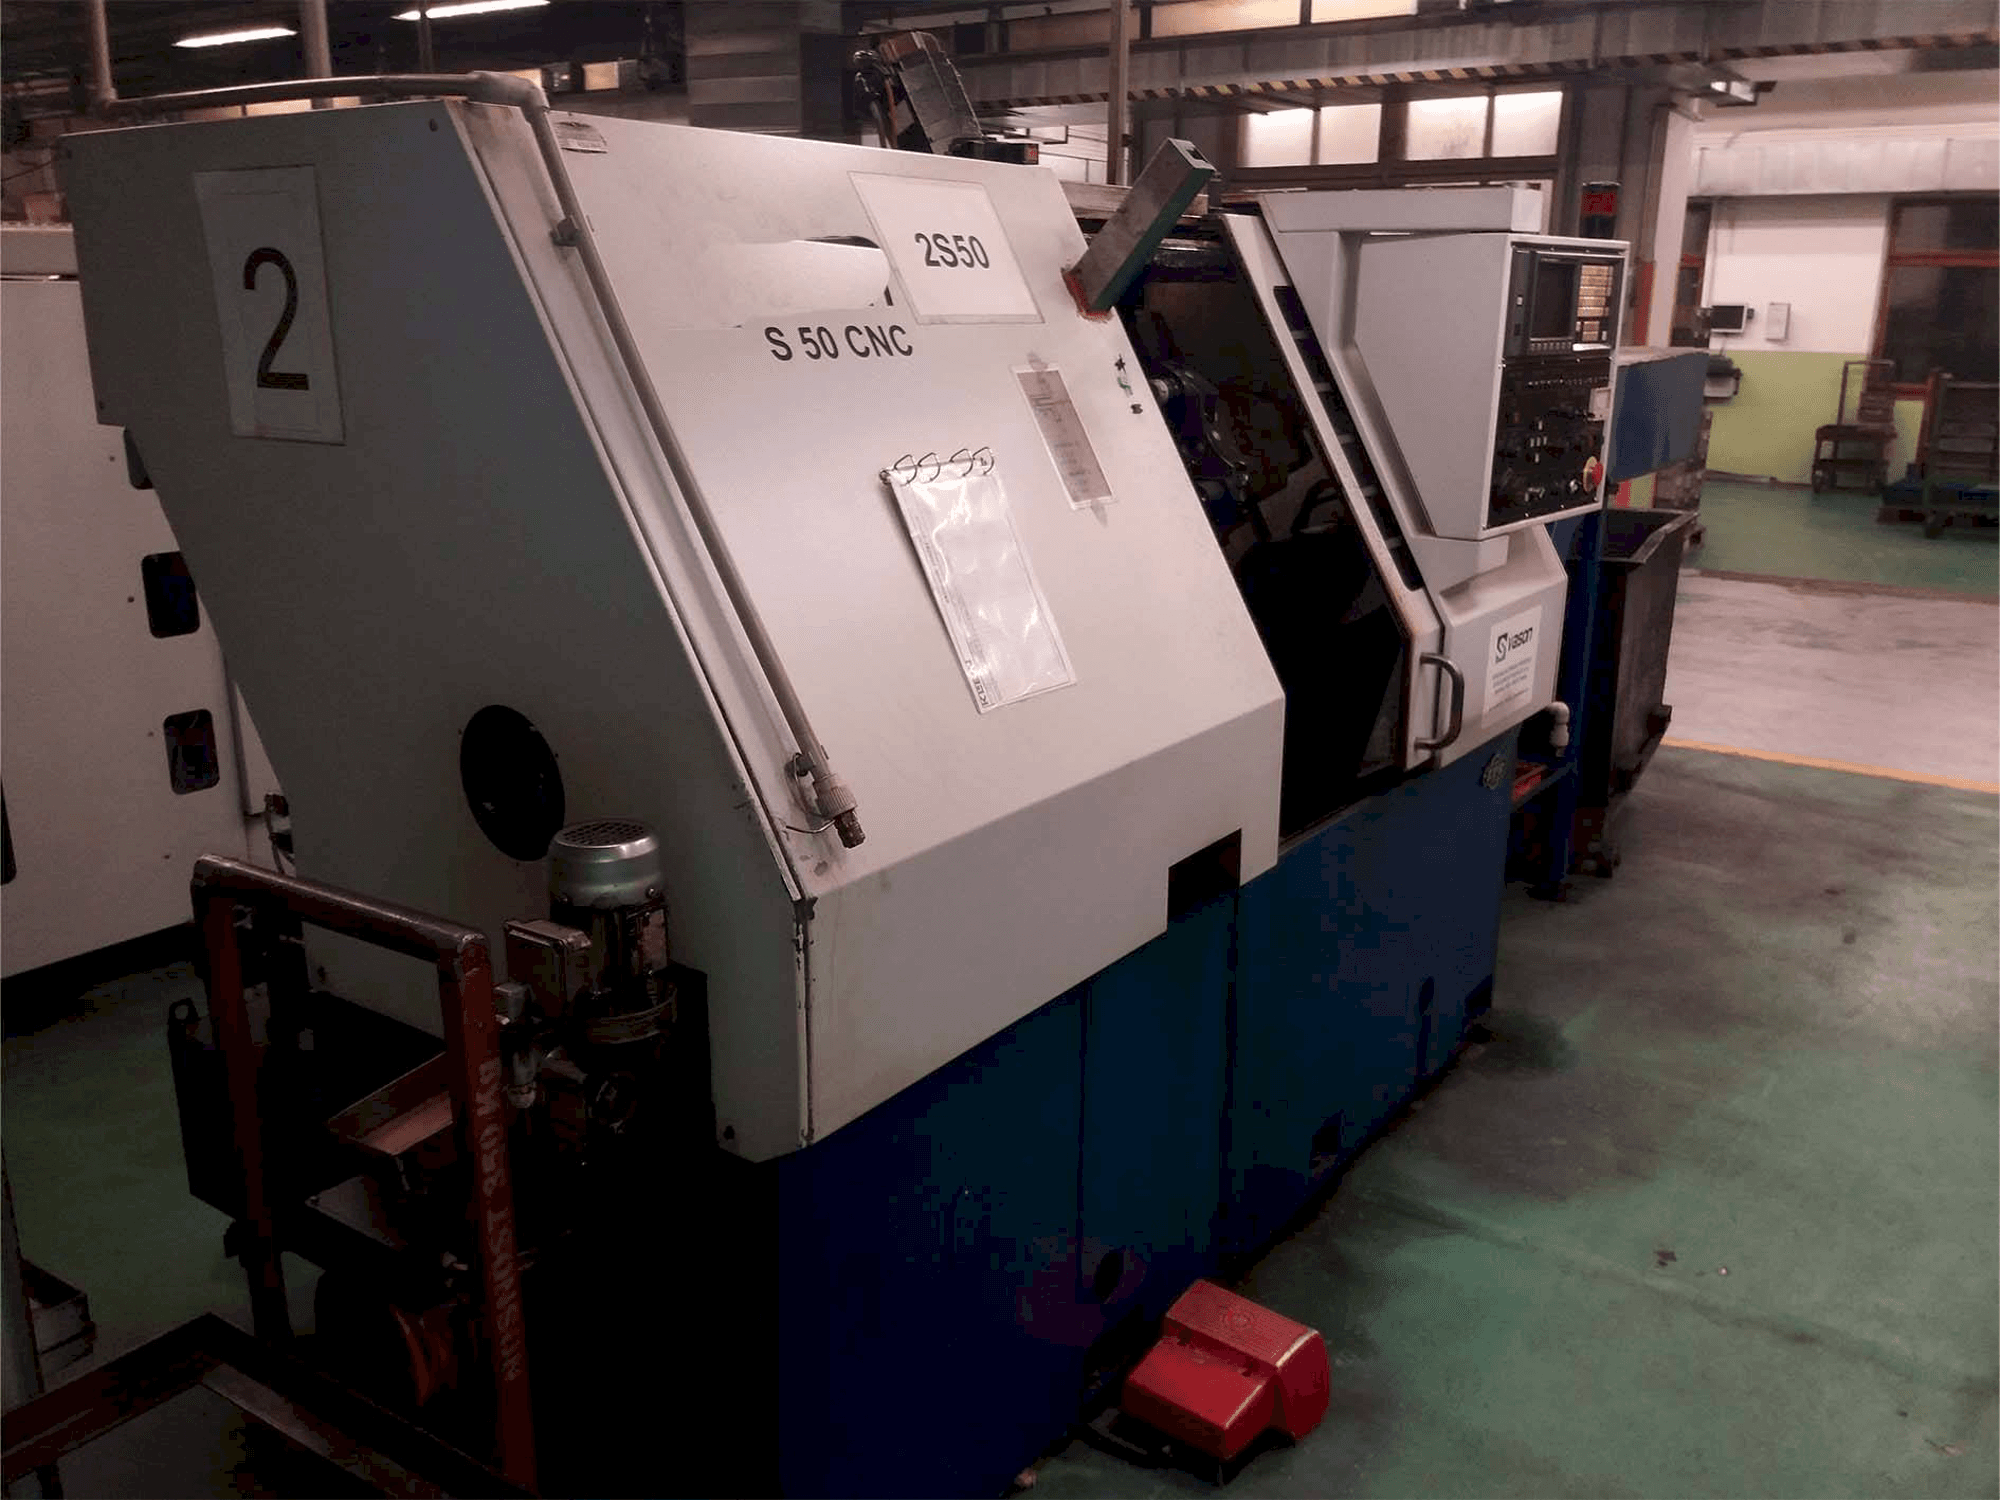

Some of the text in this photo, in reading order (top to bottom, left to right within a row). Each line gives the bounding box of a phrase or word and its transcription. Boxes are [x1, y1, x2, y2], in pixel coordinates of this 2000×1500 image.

[915, 233, 990, 269] 2S50
[243, 247, 309, 390] 2
[765, 325, 913, 361] S 50 CNC
